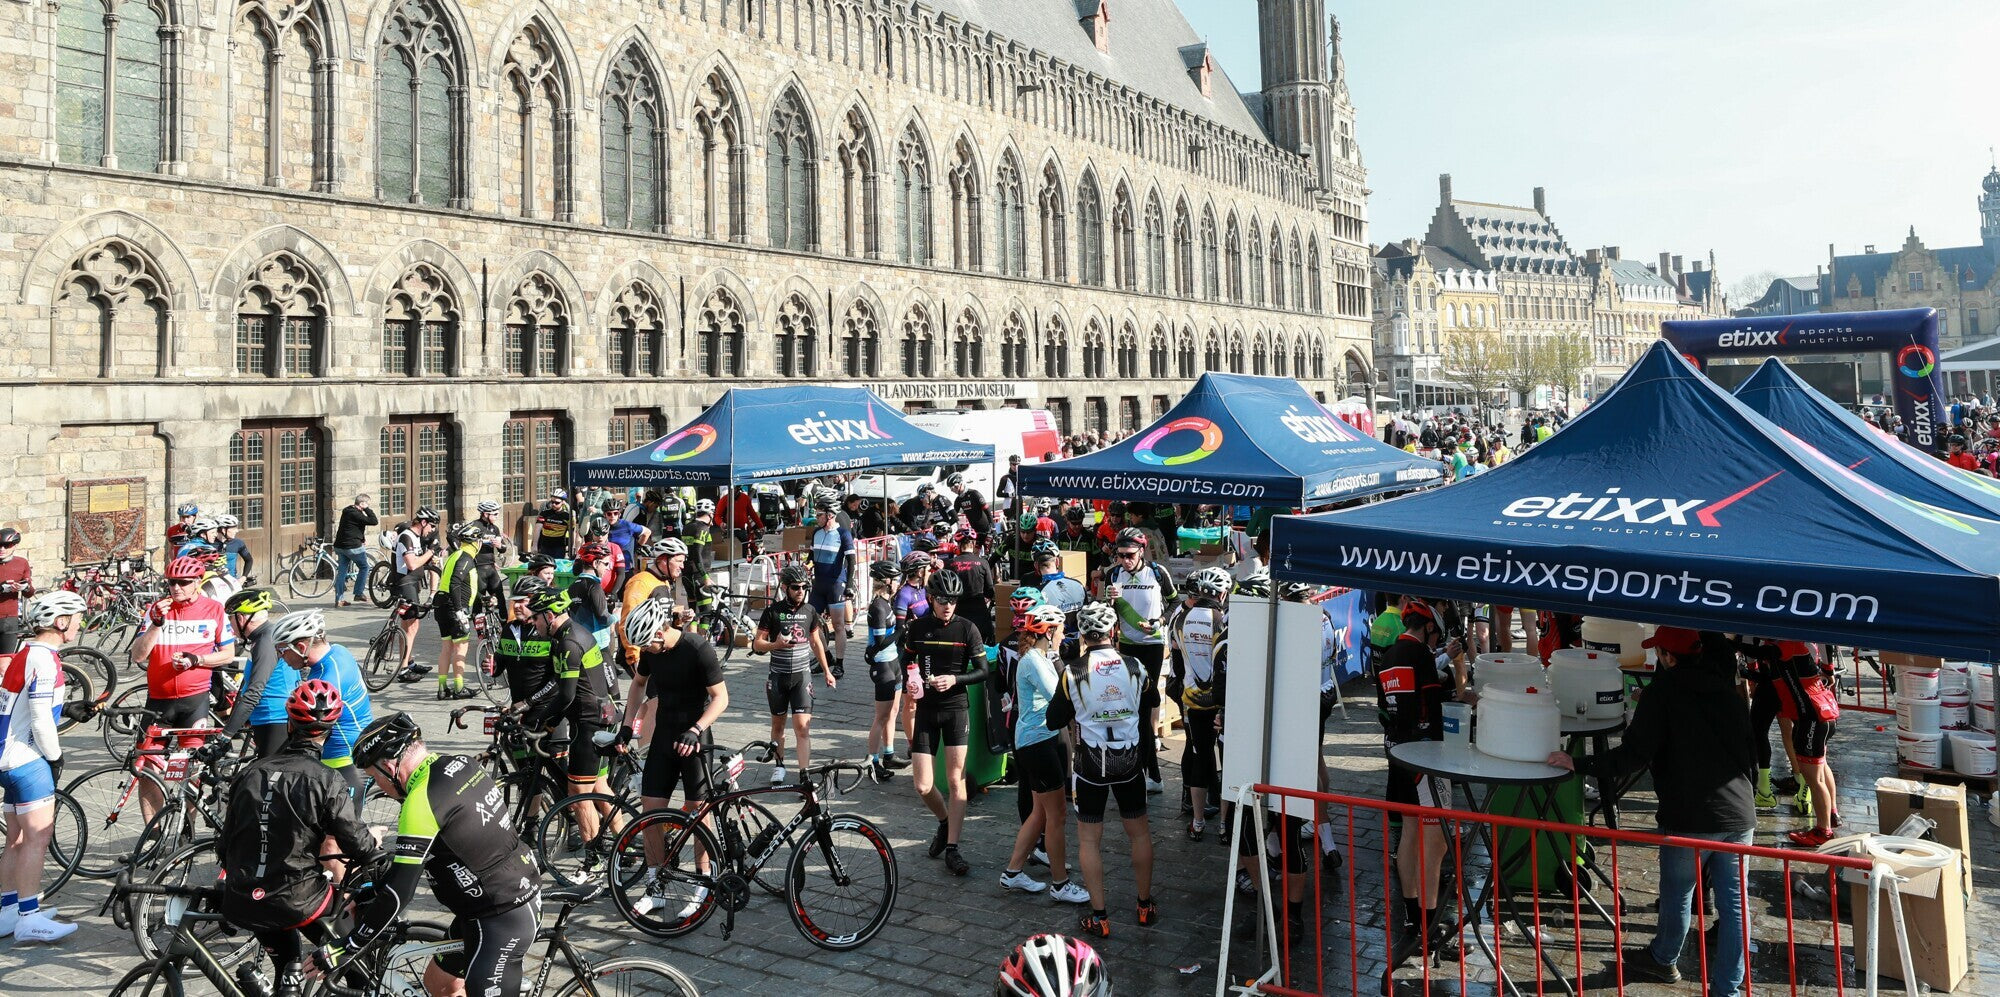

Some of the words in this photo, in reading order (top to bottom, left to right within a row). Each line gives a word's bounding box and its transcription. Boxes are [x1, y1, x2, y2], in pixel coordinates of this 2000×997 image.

[1718, 327, 1779, 347] etixx
[1799, 327, 1852, 335] sports
[1799, 335, 1874, 344] nutrition
[878, 383, 936, 398] FLANDERS
[938, 383, 973, 398] FIELDS
[976, 383, 1015, 398] MUSEUM
[787, 410, 875, 445] etixx
[1280, 404, 1354, 443] etixx
[1911, 399, 1933, 446] etixx
[811, 445, 851, 453] sports
[855, 440, 905, 449] nutrition
[902, 449, 985, 462] www.etixxsports.com
[588, 466, 711, 483] www.etixxsports.com
[752, 456, 870, 478] wwwetixxsports.com
[1049, 473, 1265, 499] www.etixxsports.com
[1501, 487, 1705, 527] etixx
[1493, 520, 1574, 530] sports
[1593, 525, 1720, 540] nutrition
[1340, 545, 1879, 623] www.etixxsports.com
[166, 771, 184, 779] 6795
[446, 863, 472, 888] plaza
